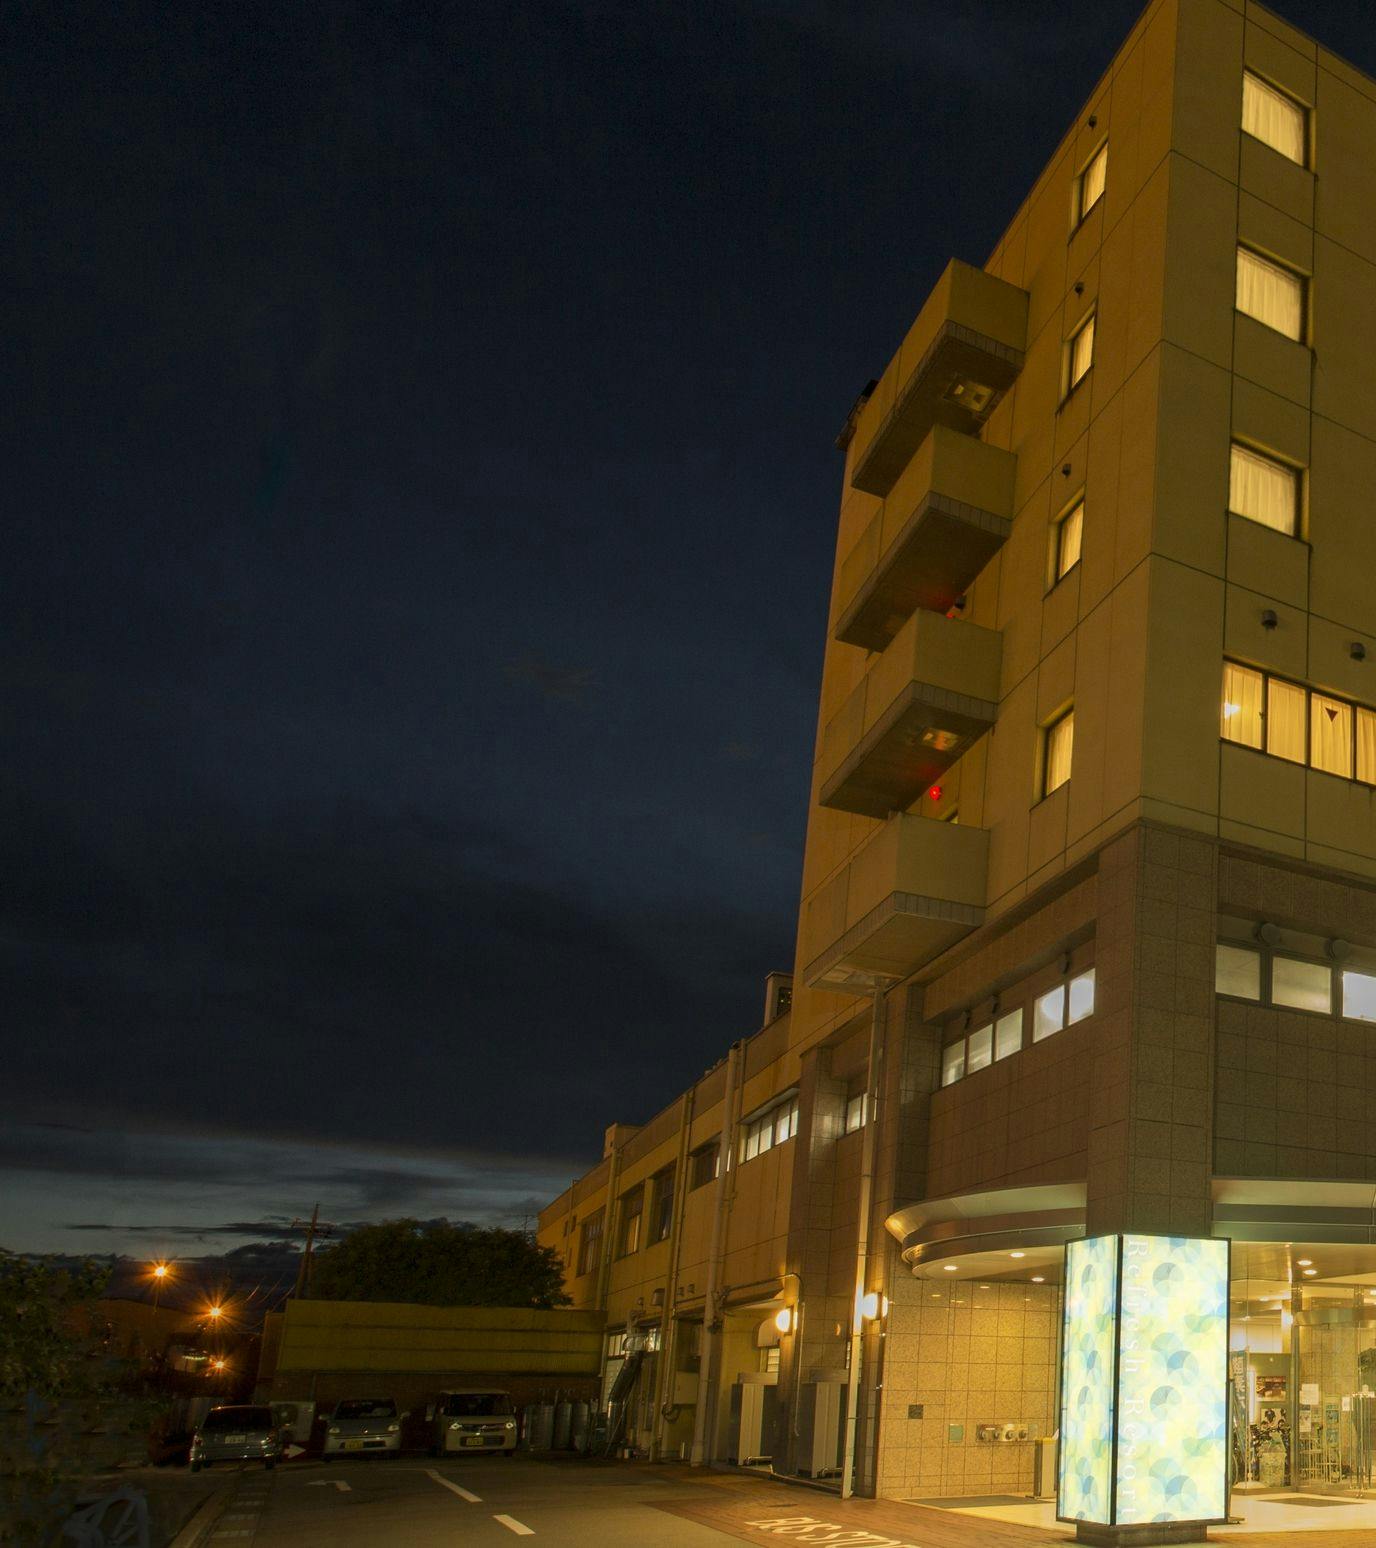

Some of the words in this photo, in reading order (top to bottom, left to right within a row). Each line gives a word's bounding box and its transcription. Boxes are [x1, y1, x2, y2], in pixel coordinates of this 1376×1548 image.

[1125, 1240, 1149, 1373] Refresh
[1121, 1398, 1145, 1515] Resort
[744, 1517, 842, 1534] BUS
[796, 1531, 921, 1548] STO
